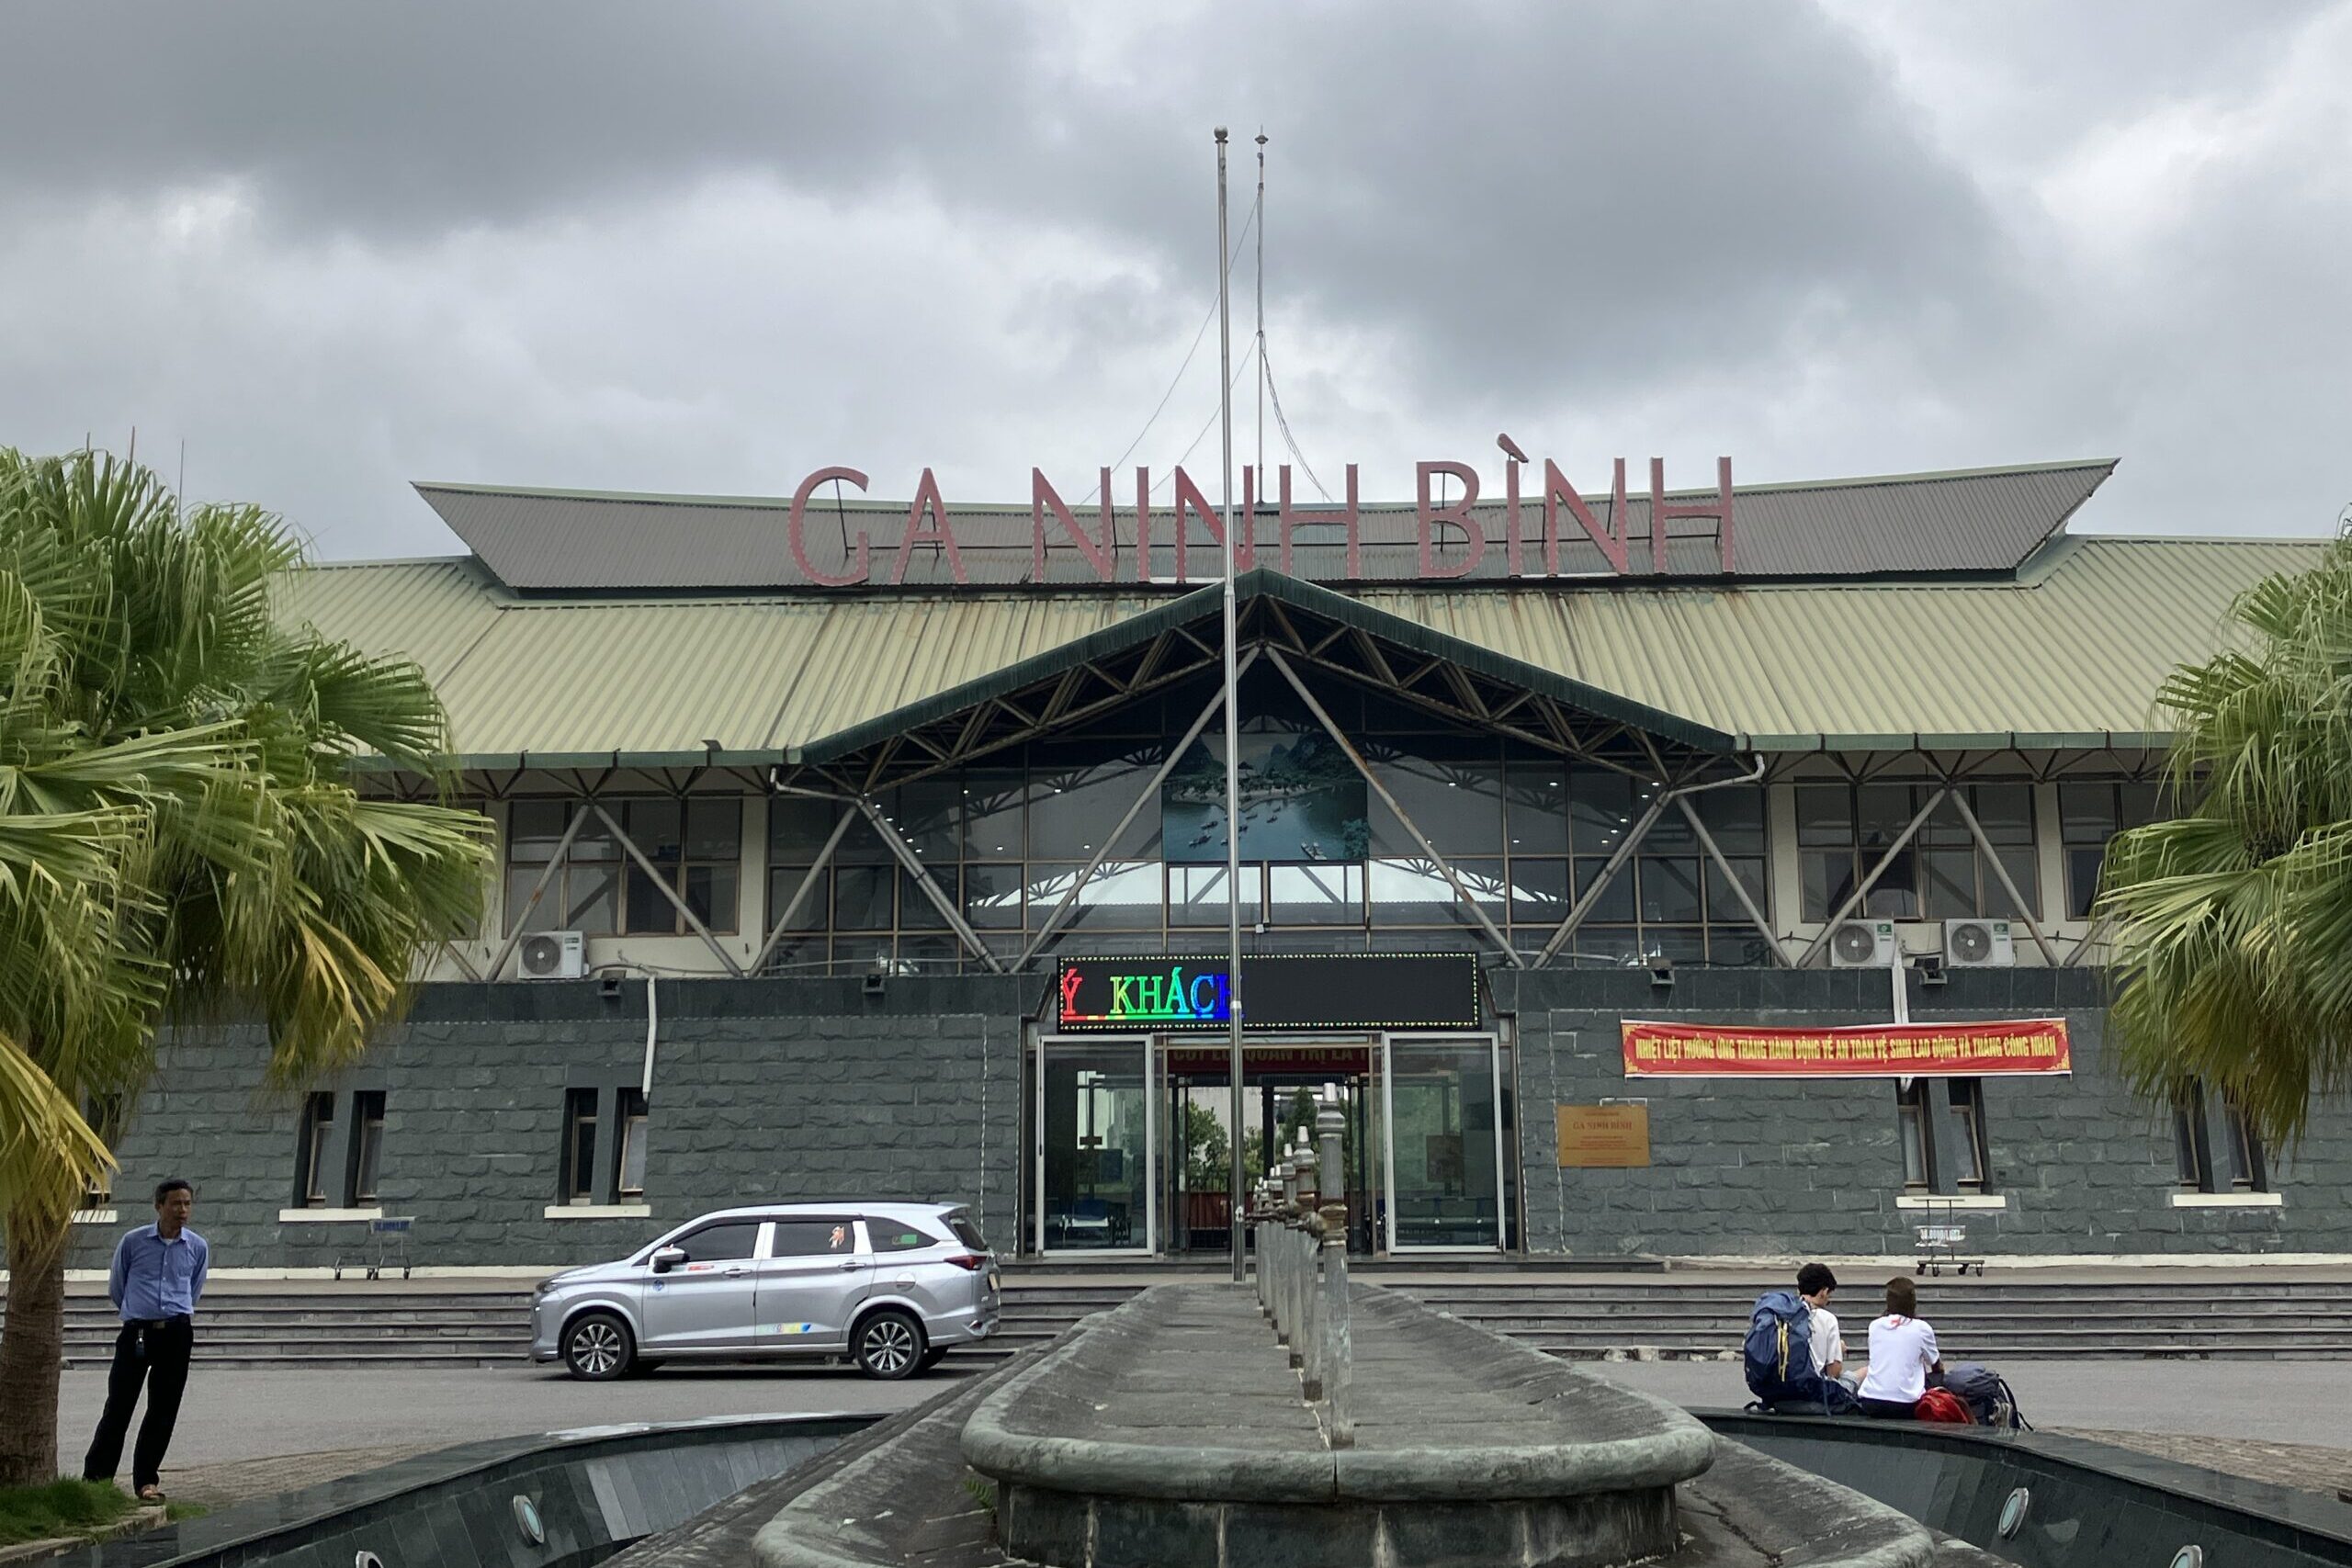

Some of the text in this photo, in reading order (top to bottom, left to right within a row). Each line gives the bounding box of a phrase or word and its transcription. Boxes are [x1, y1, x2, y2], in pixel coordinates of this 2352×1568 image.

[787, 433, 1736, 587] GA NINH BÌNH
[1635, 1034, 1661, 1064] NHIỆT
[1663, 1035, 1681, 1064] LIỆT
[1683, 1032, 1714, 1059] HƯỞNG
[1716, 1034, 1736, 1059] ỨNG
[1736, 1035, 1767, 1060] THÁNG
[1768, 1035, 1793, 1060] HÀNH
[1794, 1035, 1821, 1065] ĐỘNG
[1836, 1039, 1849, 1059] AN
[1849, 1034, 1874, 1059] TOÀN
[1876, 1034, 1889, 1064] VỆ
[1889, 1038, 1912, 1058] SINH
[1913, 1038, 1930, 1058] LAO
[1932, 1033, 1957, 1063] ĐỘNG
[1958, 1033, 1972, 1058] VÀ
[1973, 1032, 2003, 1057] THÁNG
[2004, 1032, 2030, 1057] CÔNG
[2030, 1032, 2057, 1056] NHÂN
